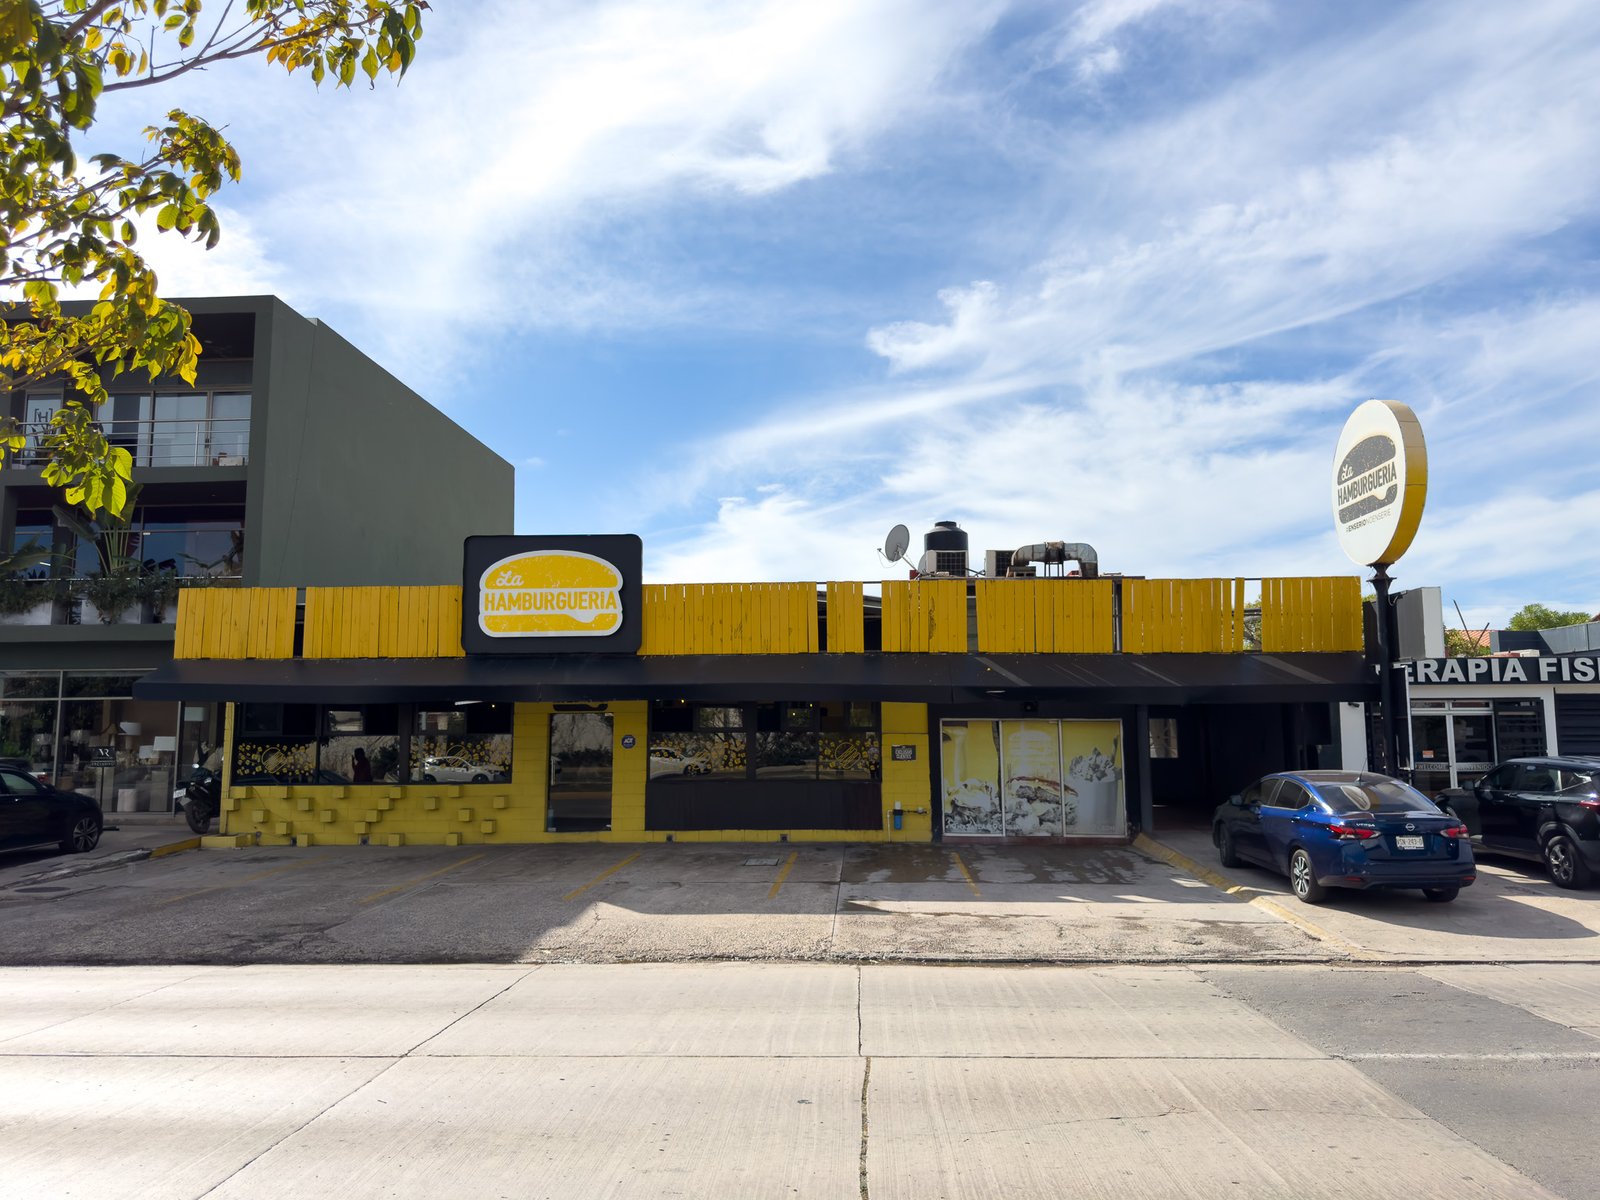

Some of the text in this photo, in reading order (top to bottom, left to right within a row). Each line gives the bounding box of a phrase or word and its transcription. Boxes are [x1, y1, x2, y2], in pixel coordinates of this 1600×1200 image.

[1341, 464, 1354, 481] La
[1337, 461, 1397, 506] HAMBURGUERIA
[496, 570, 524, 587] La
[484, 591, 617, 611] HAMBURGUERIA
